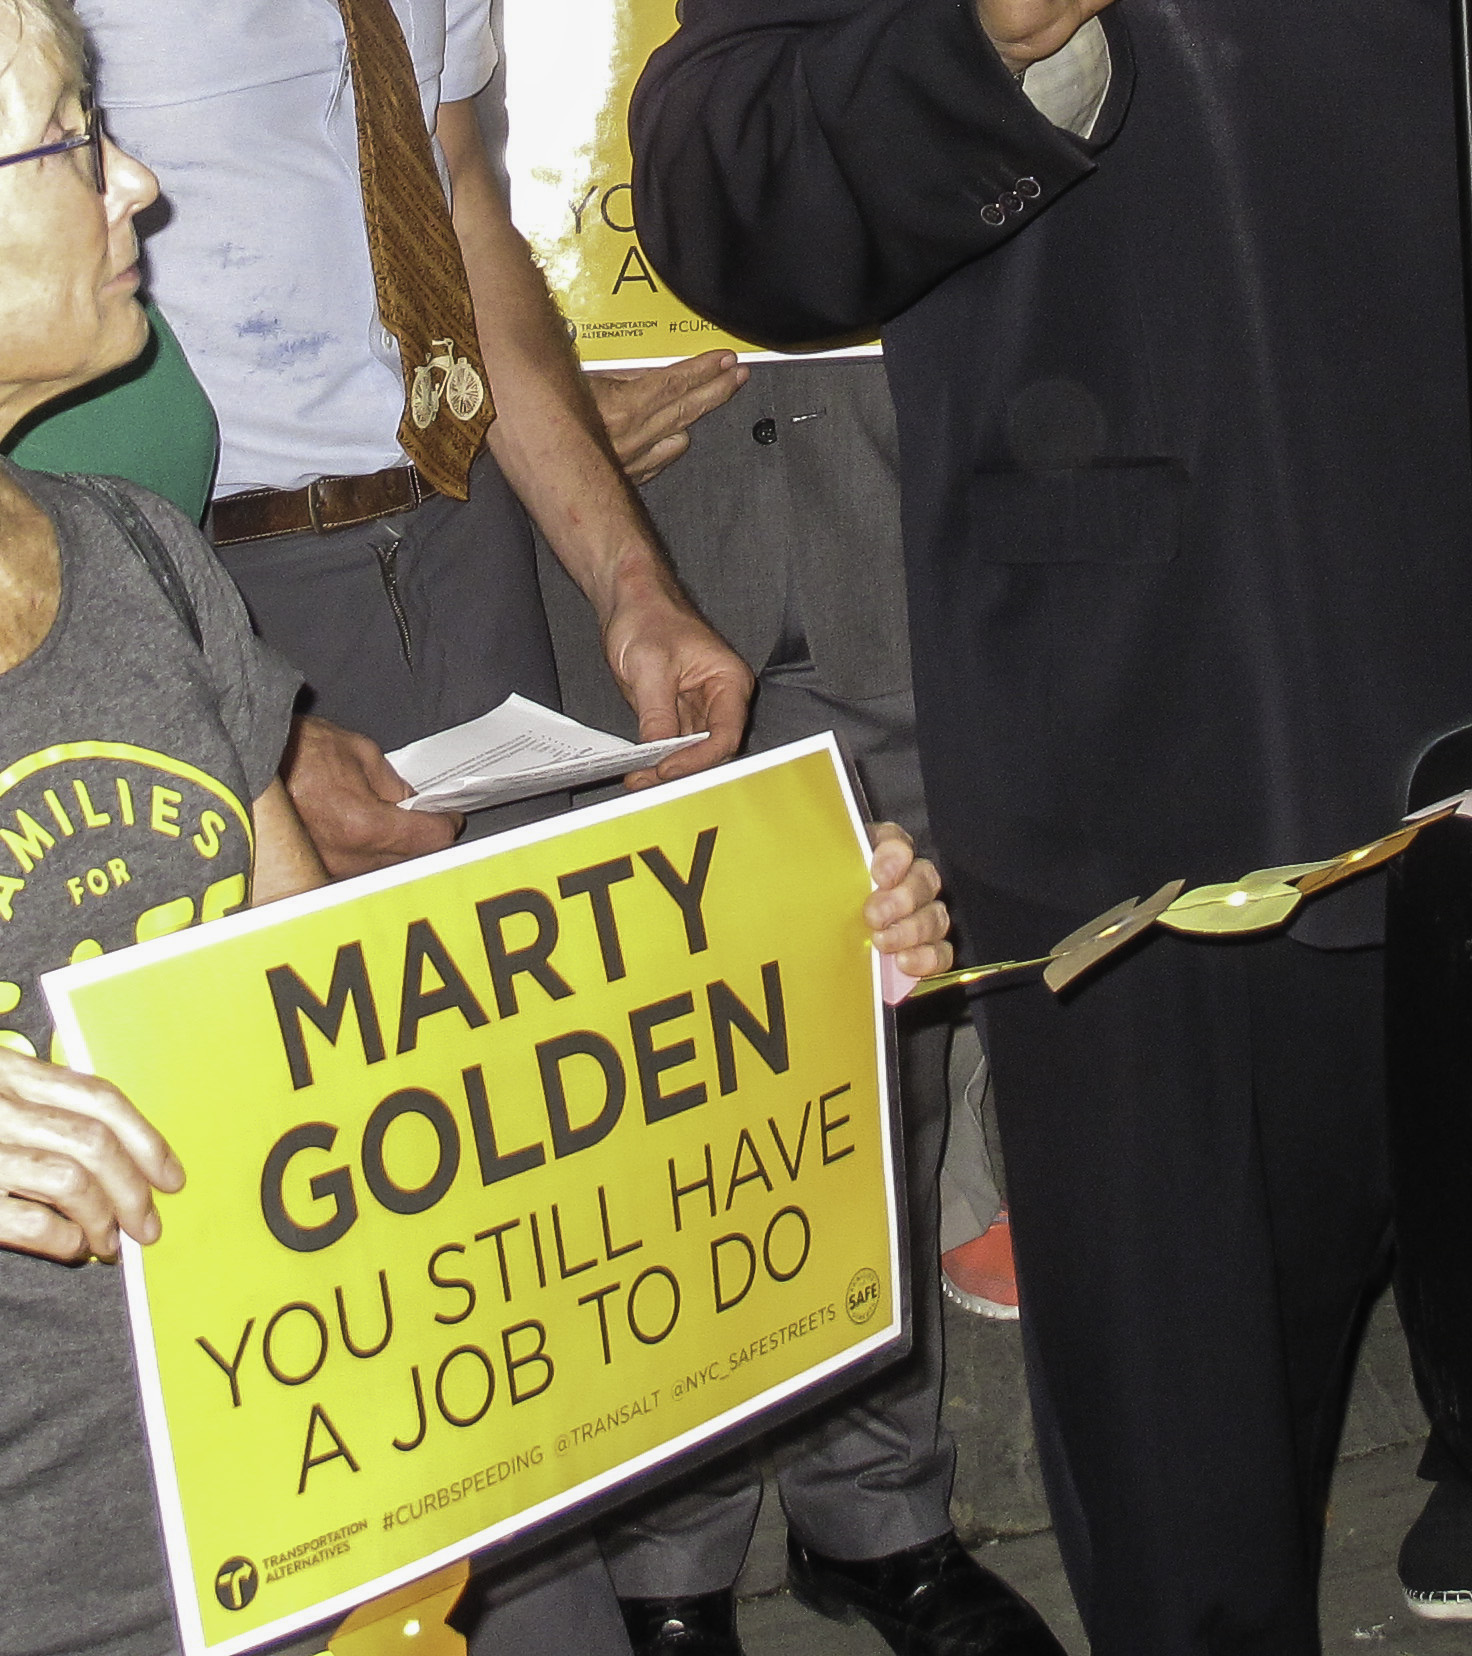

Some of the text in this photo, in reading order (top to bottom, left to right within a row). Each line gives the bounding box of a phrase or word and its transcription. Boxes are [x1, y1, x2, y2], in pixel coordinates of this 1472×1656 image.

[568, 184, 636, 234] YO
[611, 245, 659, 295] A
[581, 320, 658, 332] TRANSPORTATION
[581, 329, 644, 339] ALTERNATIVES
[67, 858, 132, 906] FOR
[265, 826, 721, 1091] MARTY
[261, 960, 792, 1253] GOLDEN
[196, 1084, 857, 1408] YOU STILL HAVE
[848, 1282, 878, 1311] SAFE
[297, 1205, 813, 1495] A JOB TO DO
[262, 1303, 837, 1571] TRANSPORTATION #CURBSPEEDING @TRANSALT @NYC_SAFESTREETS
[264, 1541, 351, 1585] ALTERNATIVES
